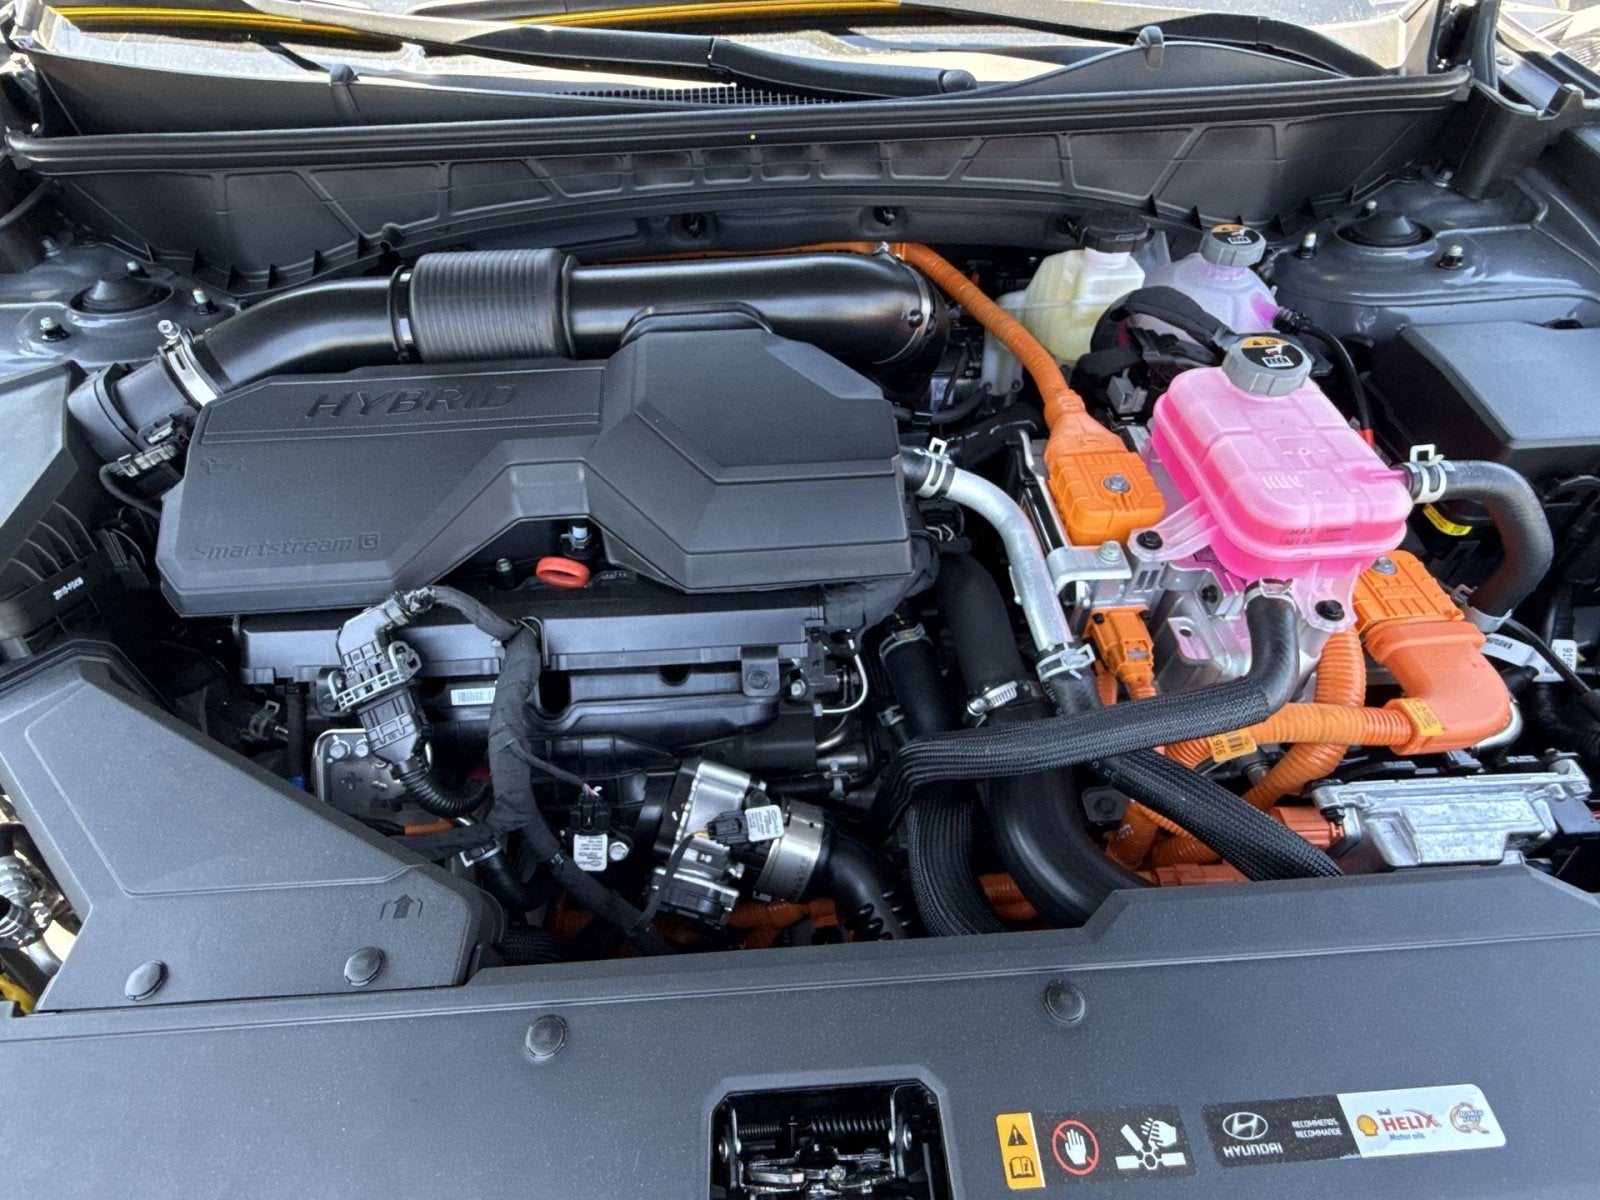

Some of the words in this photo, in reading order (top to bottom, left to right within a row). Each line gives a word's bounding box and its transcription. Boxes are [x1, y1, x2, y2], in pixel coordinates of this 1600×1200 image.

[305, 385, 518, 418] HYBRID
[191, 536, 354, 560] Smartstream
[1291, 1118, 1339, 1128] RECOMMENDS
[1380, 1112, 1438, 1131] HELIX
[1295, 1128, 1342, 1139] RECOMMANDE
[1222, 1142, 1284, 1158] HYUNDAI
